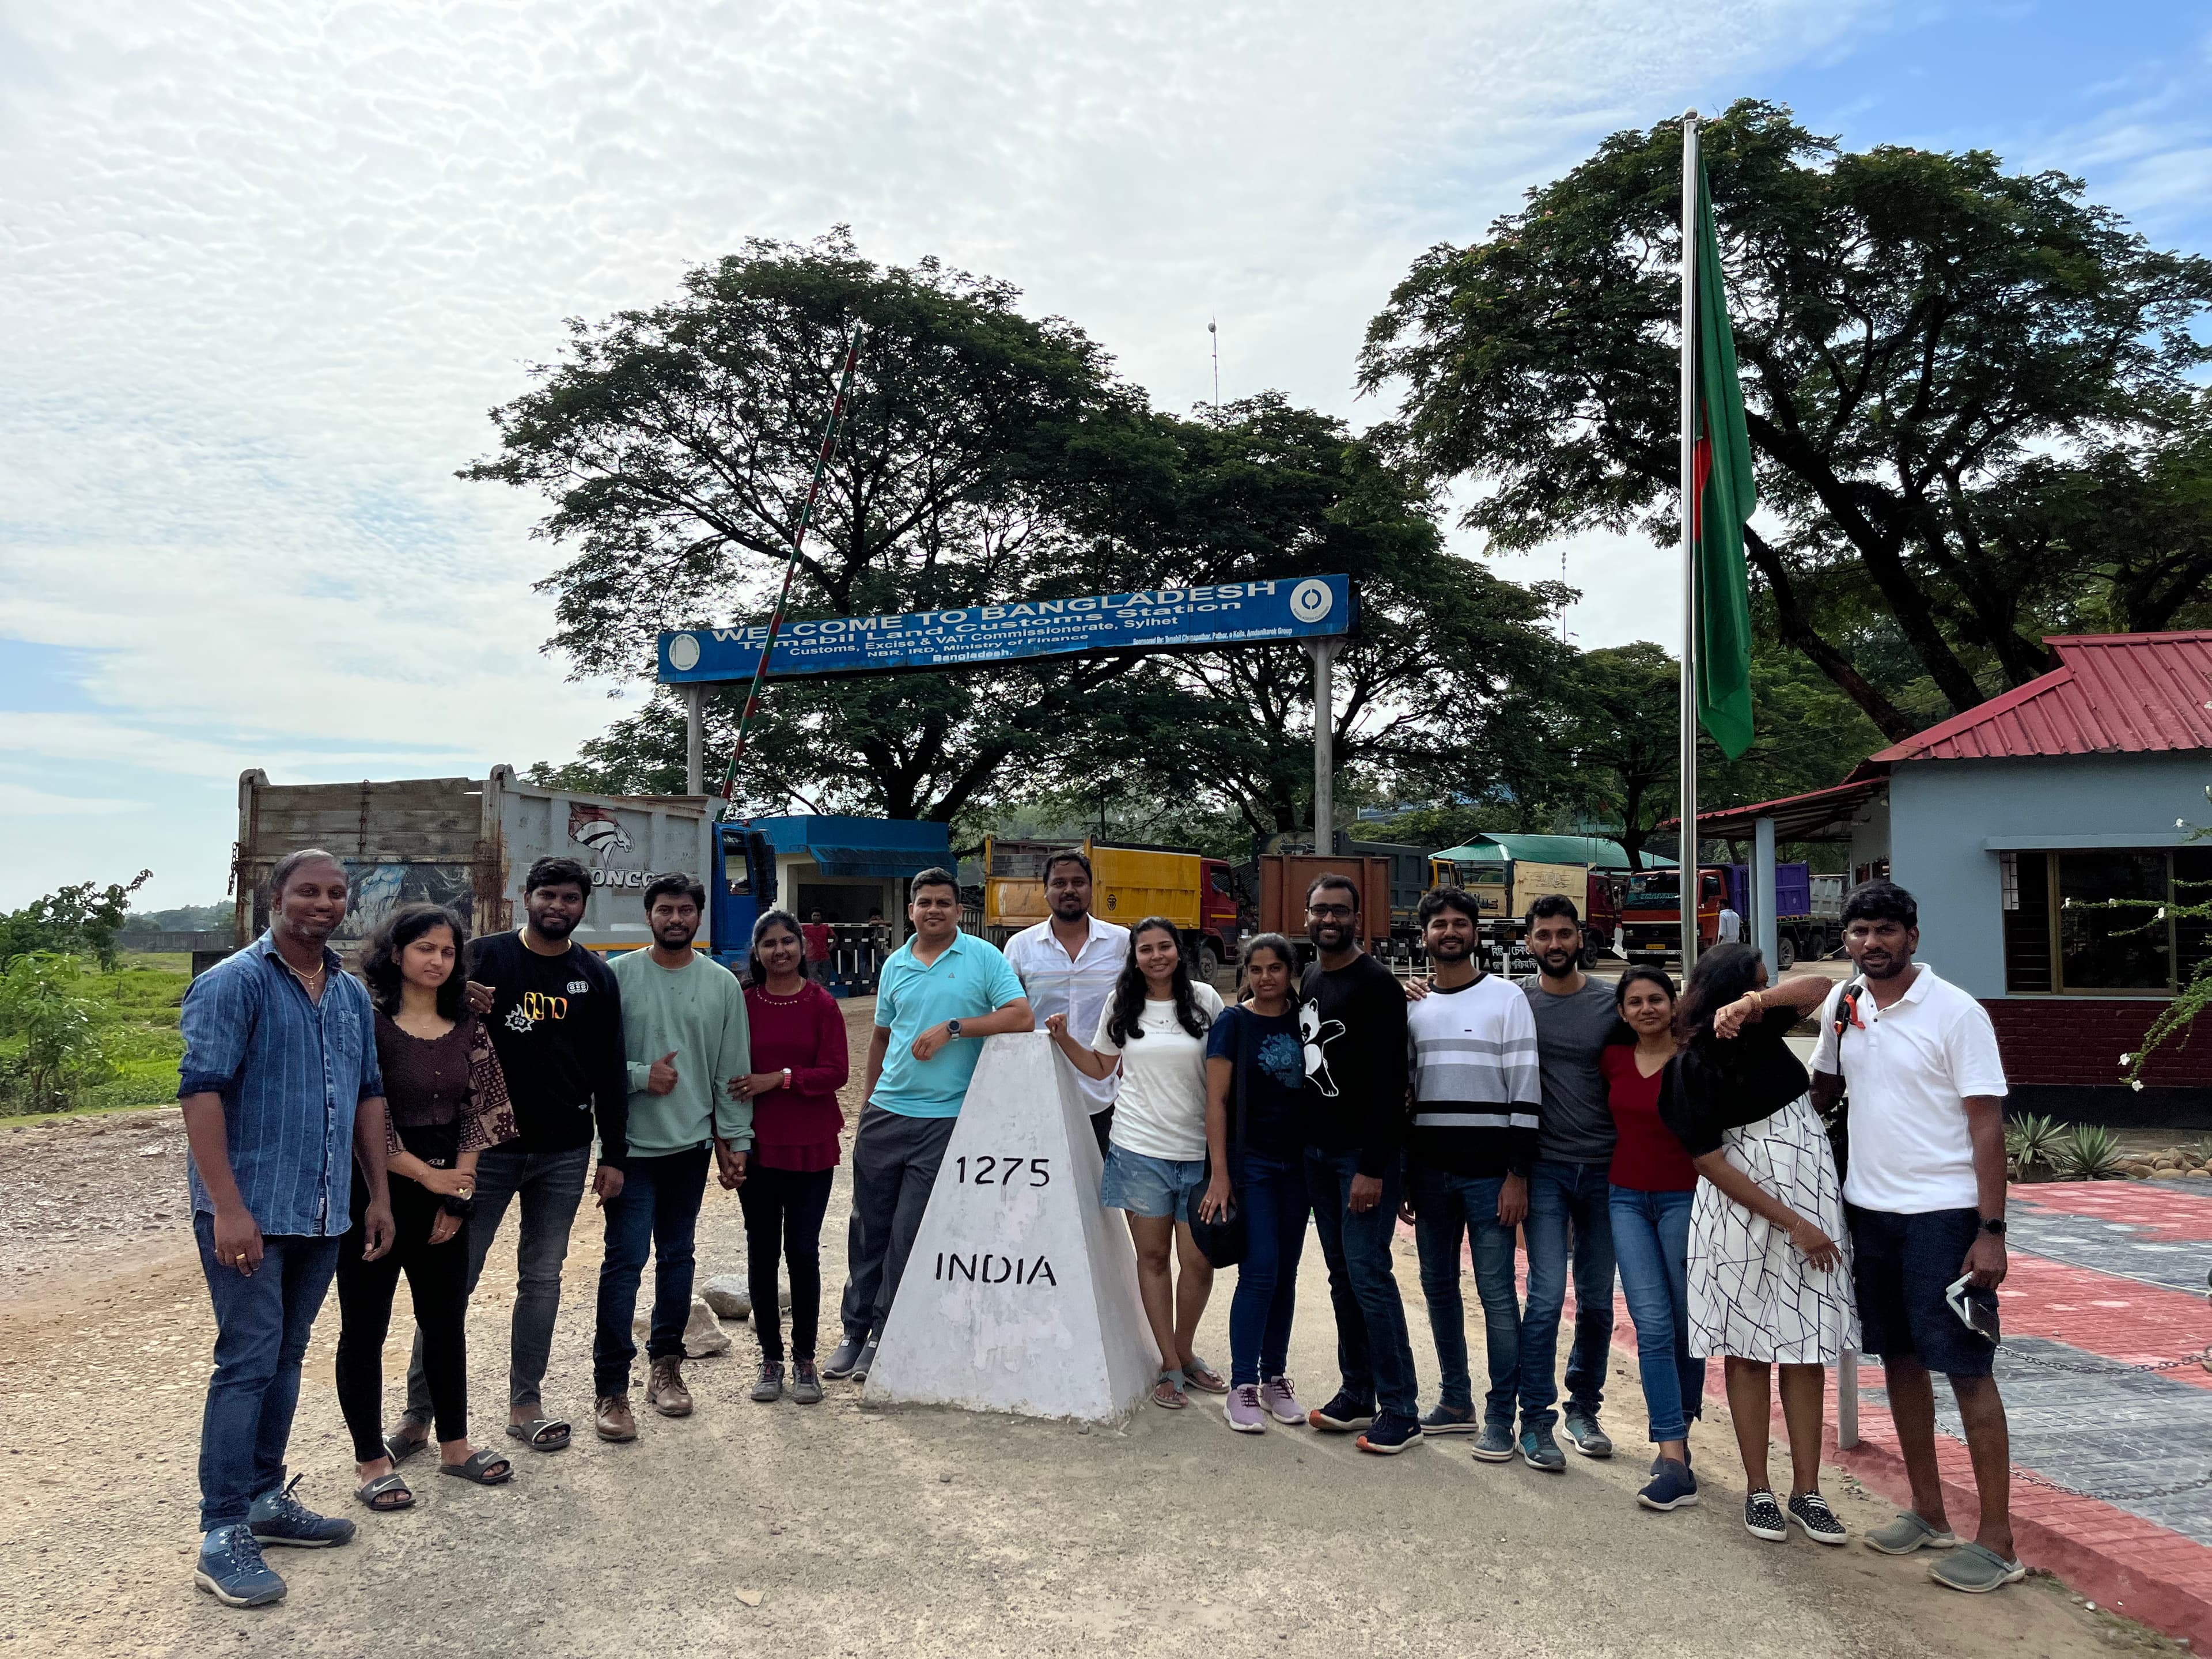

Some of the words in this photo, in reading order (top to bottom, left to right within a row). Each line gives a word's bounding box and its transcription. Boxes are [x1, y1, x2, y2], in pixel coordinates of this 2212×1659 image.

[915, 611, 967, 626] TO
[982, 582, 1275, 620] BANGLADESH
[738, 633, 854, 650] Tamabil
[867, 626, 943, 640] Land
[955, 613, 1103, 632] Customs
[1115, 602, 1241, 618] Station
[790, 645, 859, 656] Customs,
[865, 641, 915, 650] Excise
[920, 638, 931, 646] &
[936, 635, 966, 644] VAT
[971, 622, 1118, 641] Commissionerate,
[1124, 616, 1178, 629] Sylhet
[1278, 627, 1292, 636] Group
[944, 642, 1002, 652] Ministry
[1028, 635, 1089, 644] Finance
[956, 1155, 1050, 1187] 1275
[935, 1252, 1058, 1286] INDIA
